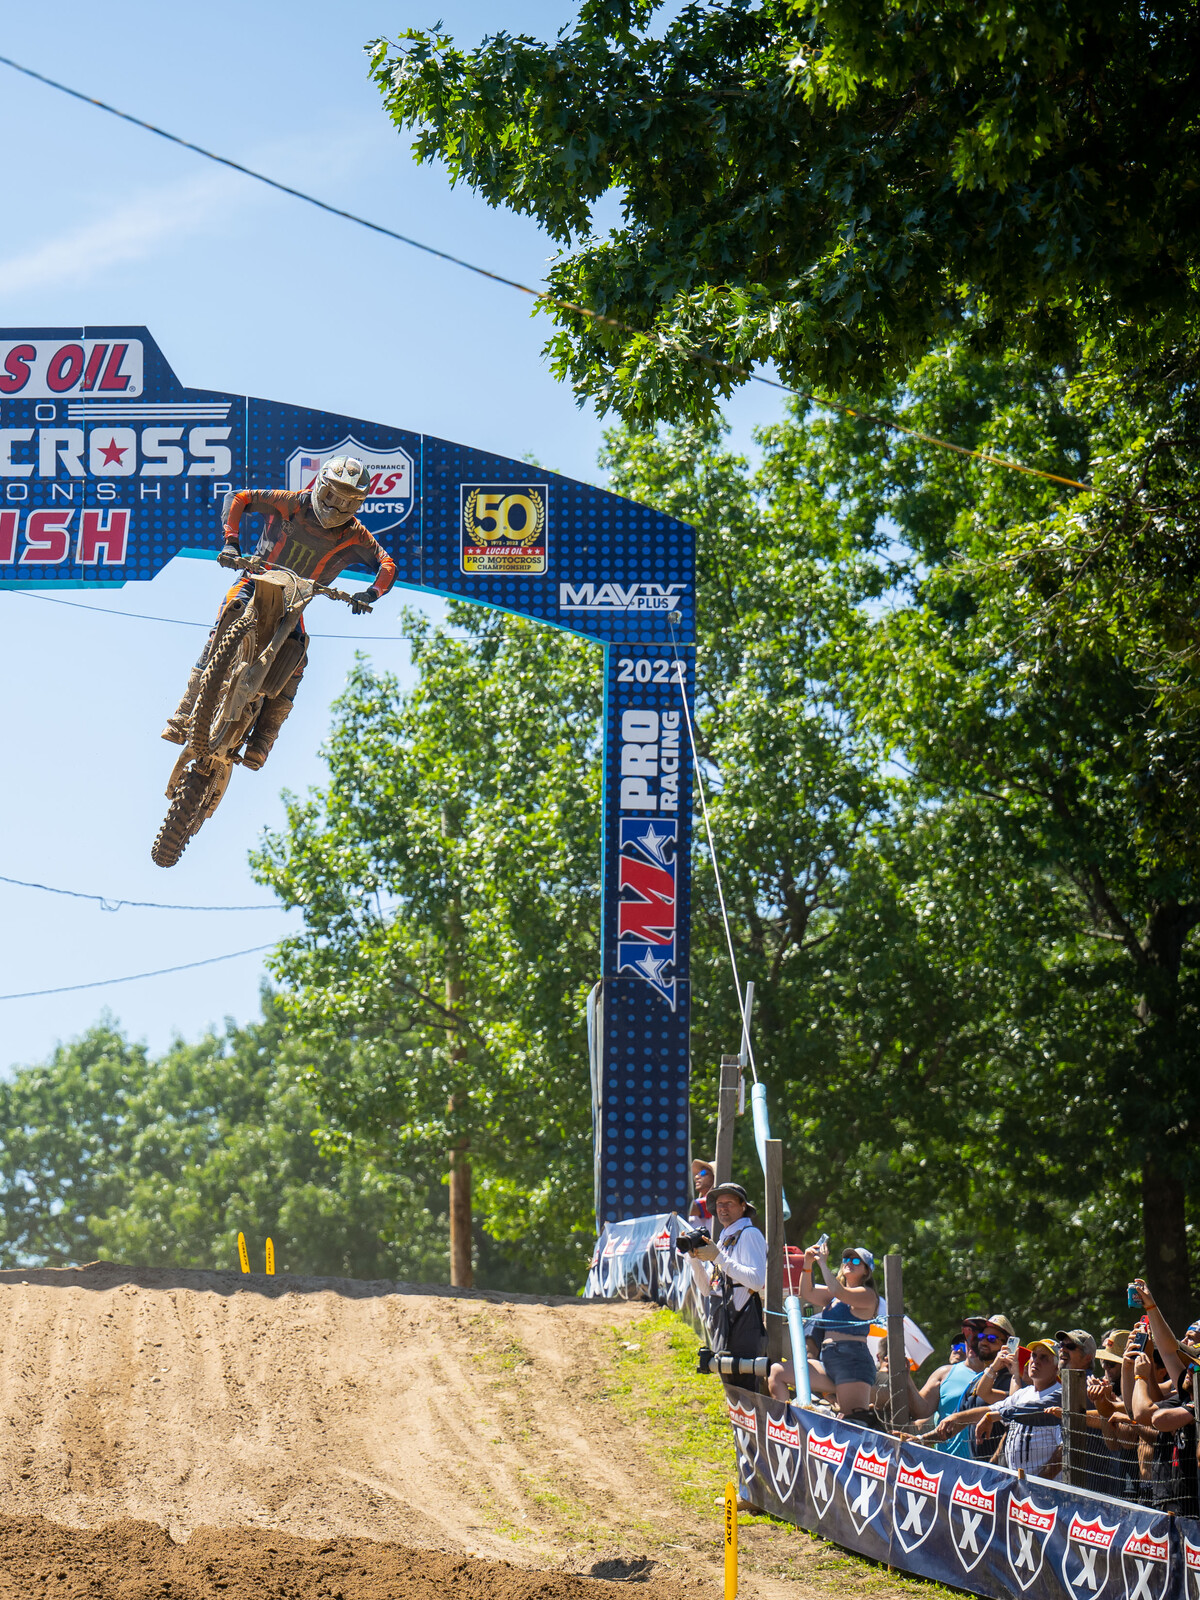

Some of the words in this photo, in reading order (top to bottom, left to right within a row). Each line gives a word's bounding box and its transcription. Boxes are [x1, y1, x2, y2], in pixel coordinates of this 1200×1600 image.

[46, 343, 132, 393] OIL
[474, 494, 538, 540] 50
[560, 583, 687, 606] MAVTV
[638, 598, 669, 608] PLUS
[617, 658, 687, 684] 2022
[620, 710, 659, 810] PRO
[660, 711, 680, 810] RACING
[769, 1426, 798, 1444] RACER
[808, 1442, 842, 1461] RACER
[775, 1444, 790, 1486] X
[814, 1459, 829, 1502] X
[856, 1458, 885, 1476] RACER
[900, 1473, 936, 1492] RACER
[850, 1476, 878, 1517] X
[900, 1491, 928, 1536] X
[955, 1490, 993, 1510] RACER
[959, 1509, 983, 1554] X
[1011, 1509, 1050, 1528] RACER
[1072, 1526, 1111, 1545] RACER
[1014, 1526, 1034, 1572] X
[1072, 1546, 1098, 1590] X
[1127, 1541, 1165, 1557] RACER
[1130, 1559, 1154, 1600] X
